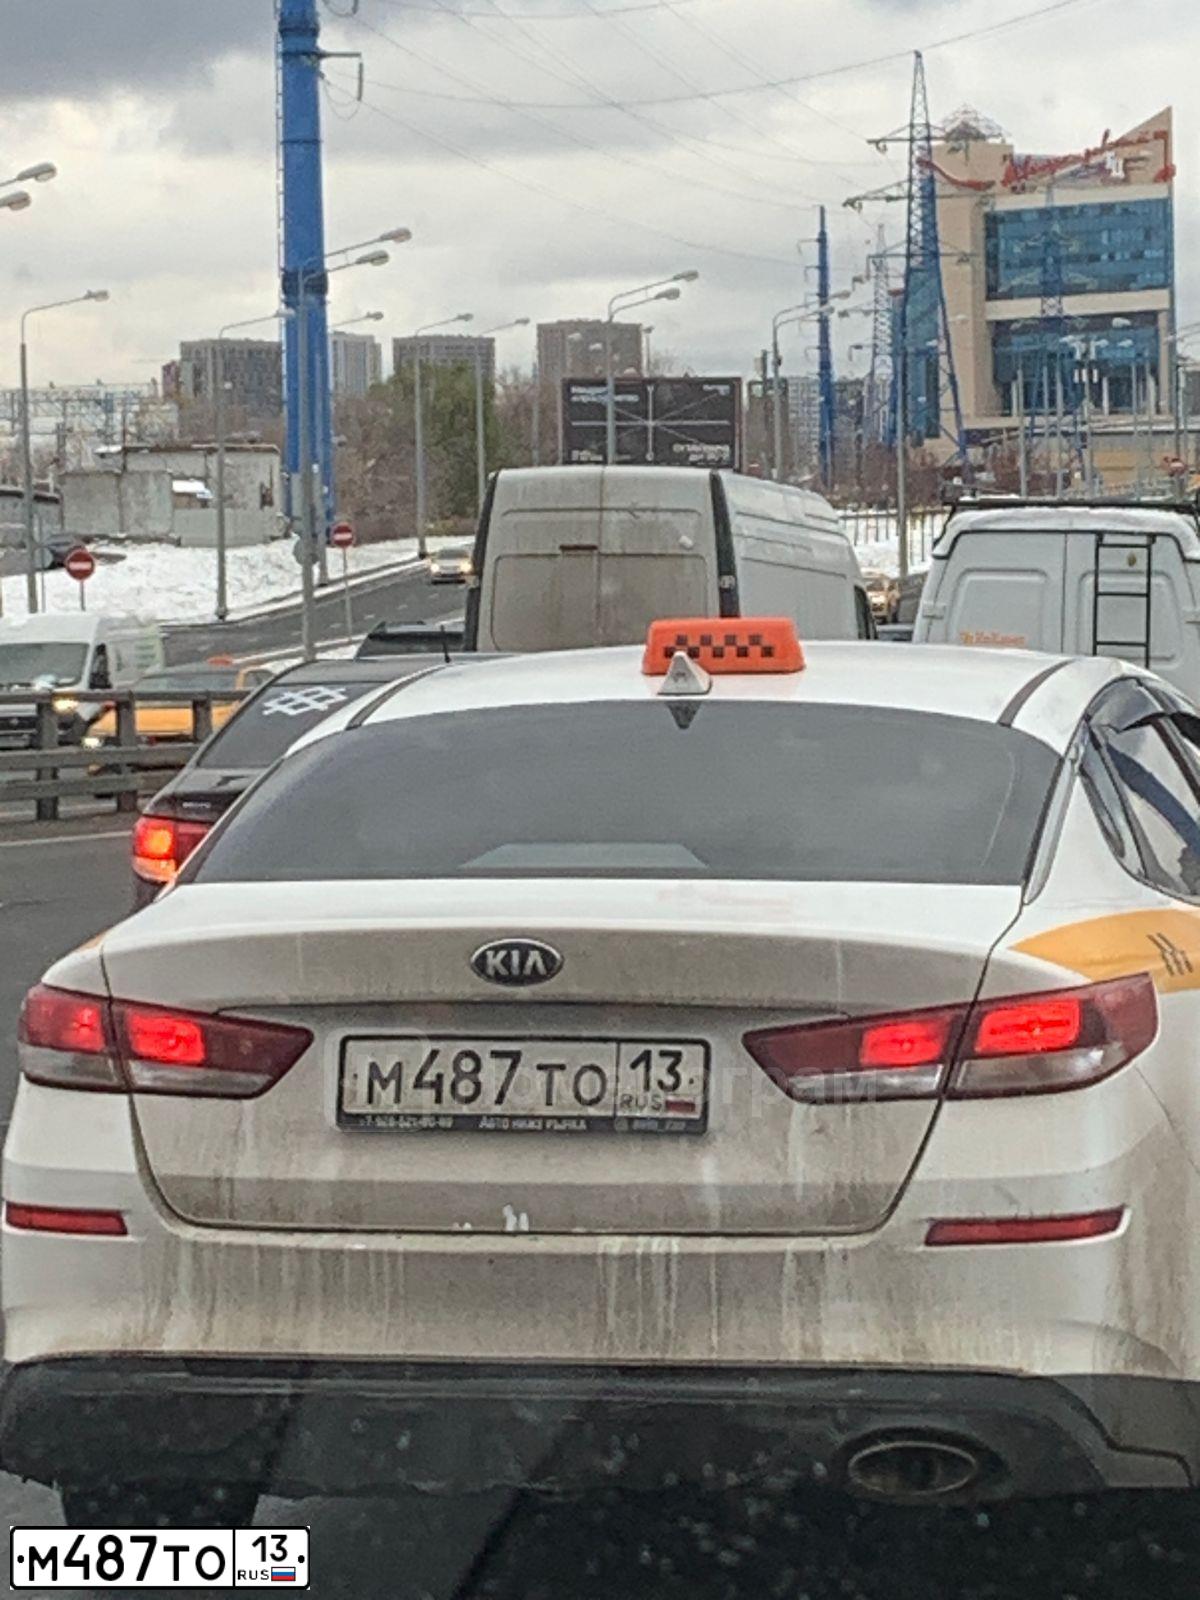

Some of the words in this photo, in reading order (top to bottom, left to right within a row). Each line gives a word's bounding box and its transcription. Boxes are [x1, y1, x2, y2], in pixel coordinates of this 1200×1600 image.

[485, 949, 548, 976] KIA
[628, 1048, 682, 1092] 13
[618, 1094, 663, 1112] RUS
